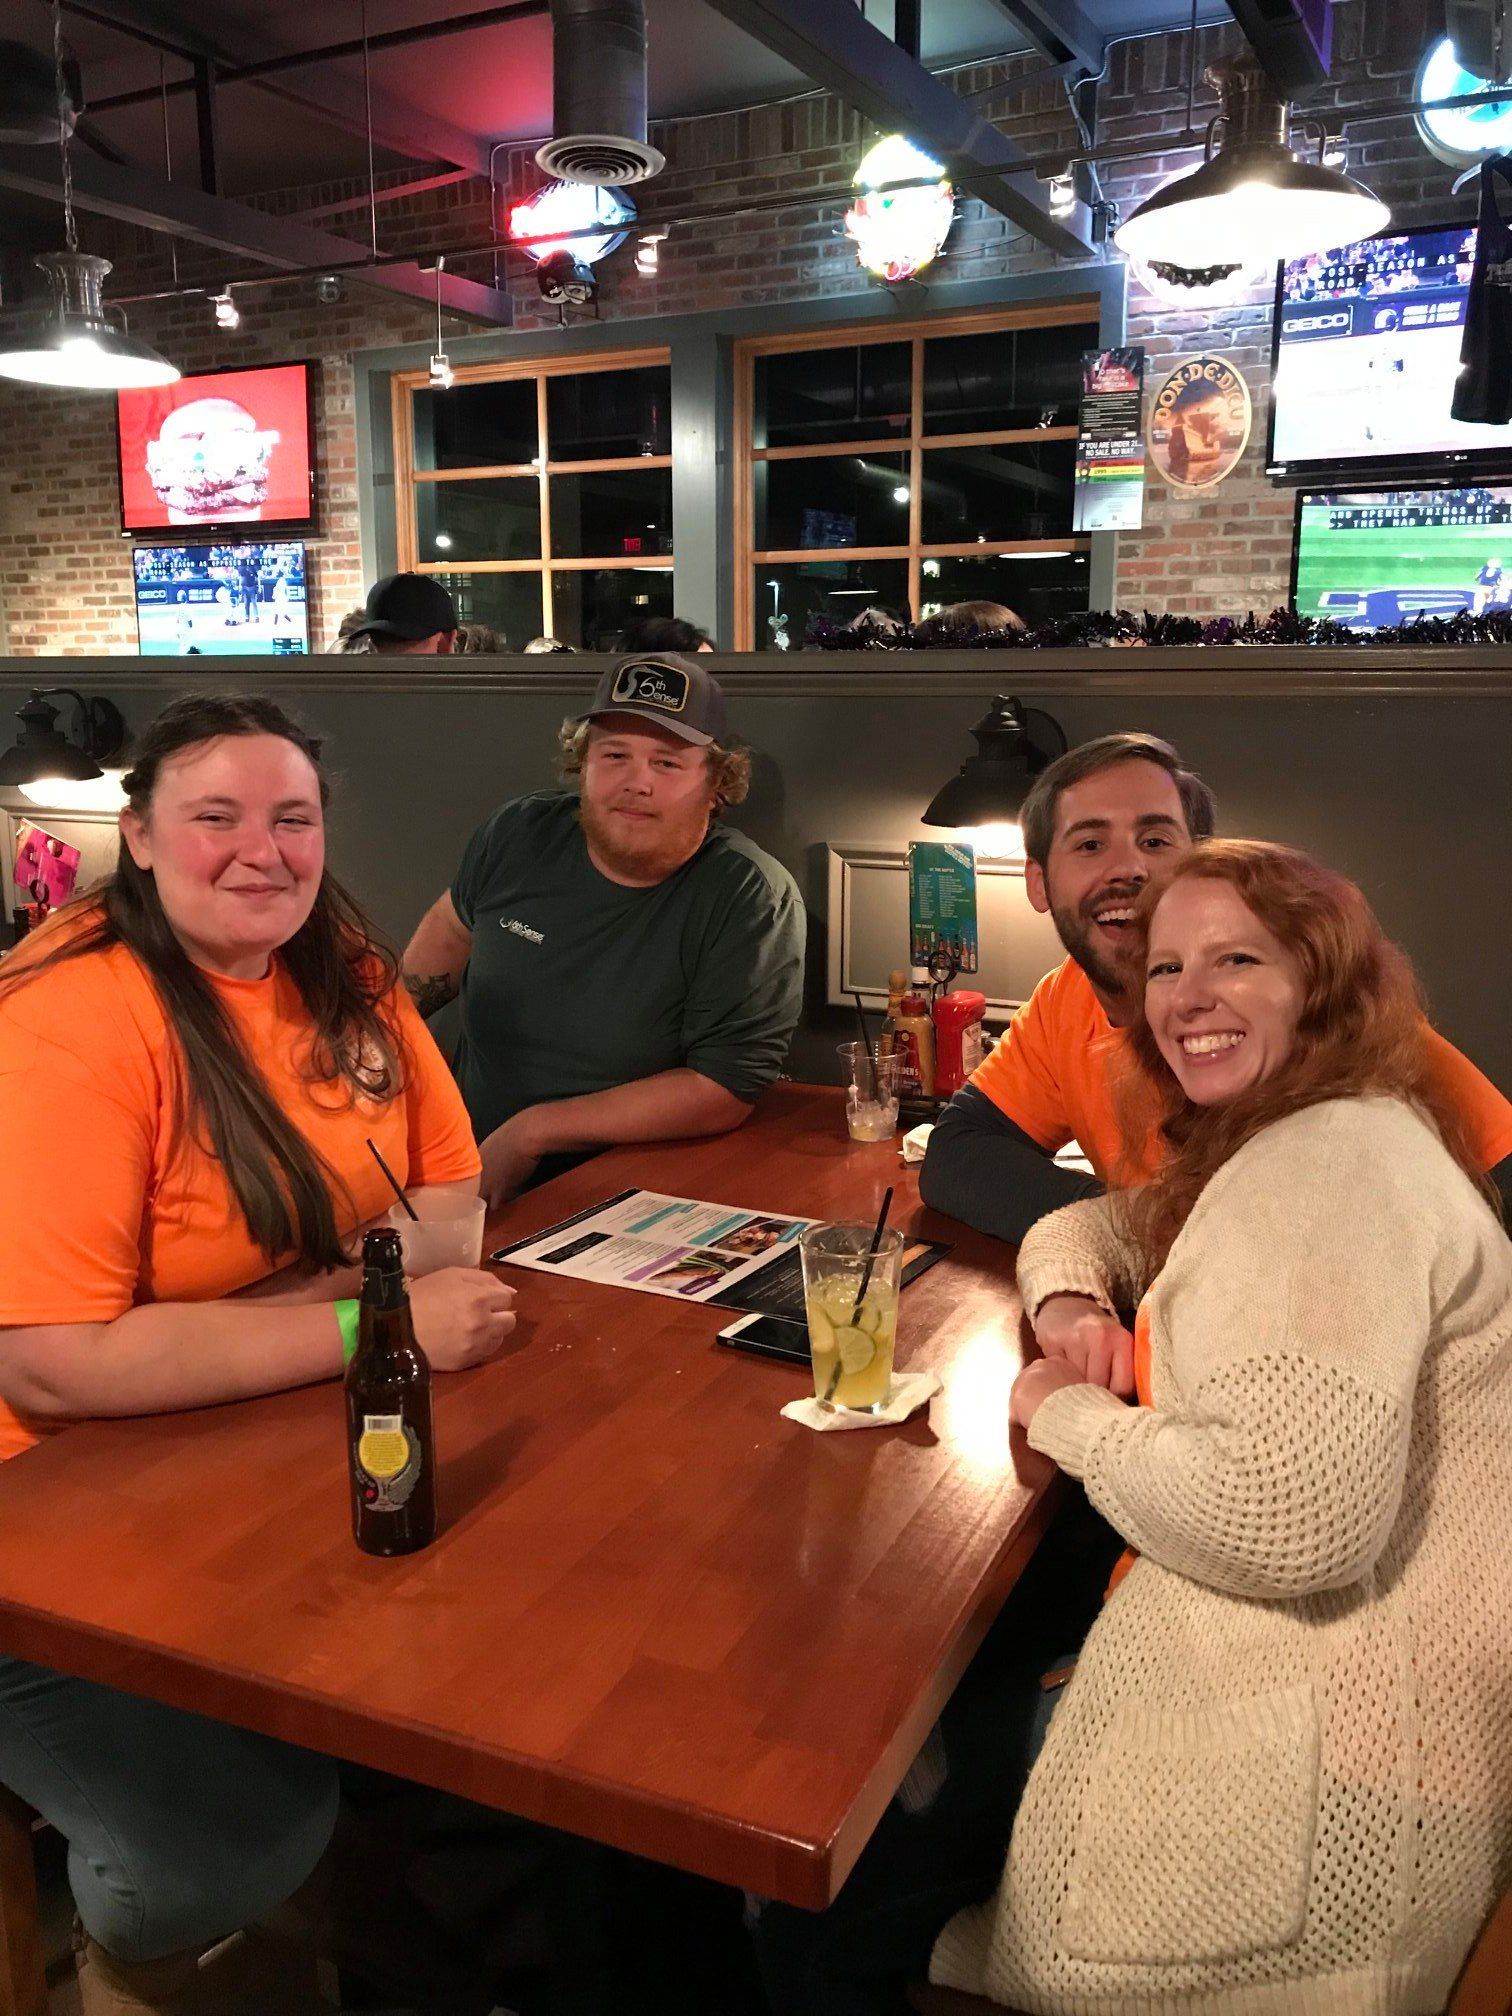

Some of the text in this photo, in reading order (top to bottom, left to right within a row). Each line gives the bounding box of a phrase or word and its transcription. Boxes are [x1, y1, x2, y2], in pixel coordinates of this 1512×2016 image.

[1437, 254, 1456, 266] AS
[1283, 313, 1349, 333] GEICO
[1078, 442, 1085, 450] IF
[1085, 442, 1098, 450] YOU
[1098, 441, 1110, 449] ARE
[1110, 440, 1130, 448] UNDER
[1085, 449, 1095, 457] NO
[1329, 510, 1352, 520] AND
[1361, 508, 1409, 519] OPENED
[1418, 506, 1467, 517] THINGS
[1476, 505, 1500, 515] UP.
[1353, 518, 1384, 528] THEY
[1392, 518, 1416, 527] HAD
[1425, 517, 1433, 526] A
[1441, 514, 1492, 525] MOMENT
[138, 589, 166, 600] GEICO
